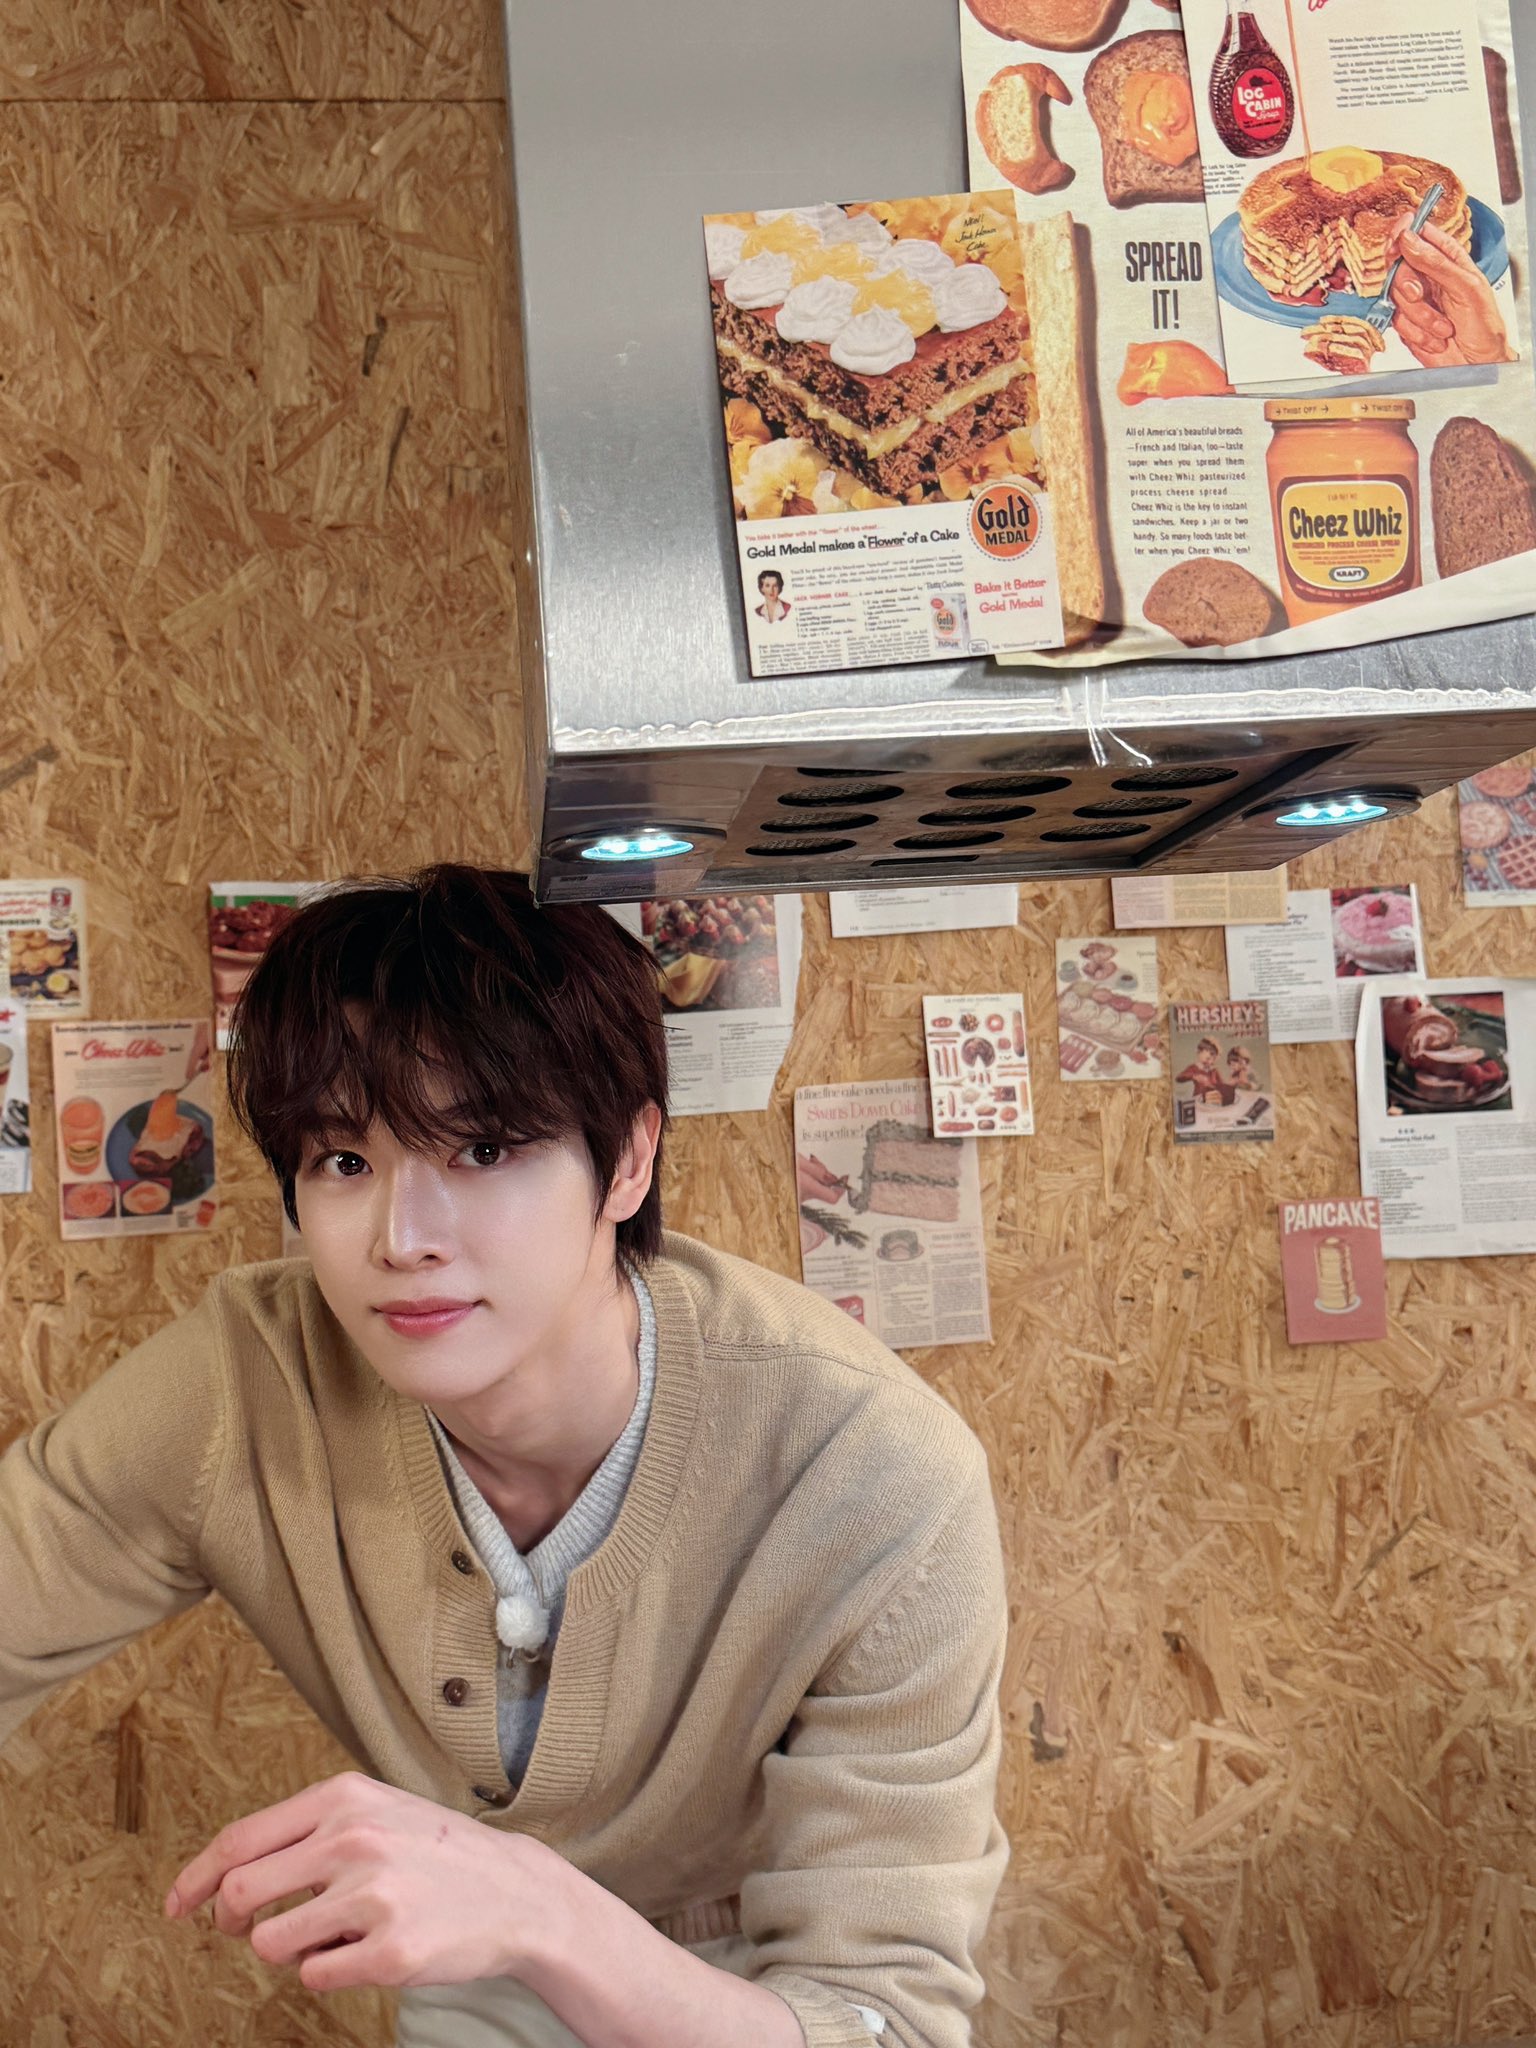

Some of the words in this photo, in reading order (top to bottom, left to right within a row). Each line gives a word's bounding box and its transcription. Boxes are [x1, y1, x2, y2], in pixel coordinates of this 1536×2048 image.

[1237, 87, 1264, 105] LOG
[1246, 97, 1281, 117] CABIN
[1125, 242, 1202, 282] SPREAD
[1153, 290, 1179, 329] IT!
[1126, 428, 1136, 436] All
[1138, 428, 1144, 436] of
[1147, 428, 1182, 436] America's
[1184, 427, 1216, 435] beautiful
[1219, 427, 1242, 435] breads
[1162, 443, 1175, 451] and
[1196, 458, 1220, 467] spread
[1226, 457, 1244, 465] them
[1150, 473, 1172, 481] Cheez
[1200, 473, 1245, 481] pasteurized
[1131, 489, 1161, 497] process
[1167, 488, 1194, 496] cheese
[977, 495, 1030, 531] Gold
[1131, 502, 1152, 511] Cheez
[1156, 503, 1172, 511] Whiz
[1176, 503, 1181, 511] is
[1184, 503, 1195, 511] the
[1198, 503, 1210, 512] key
[1213, 503, 1219, 511] to
[1180, 518, 1199, 526] Keep
[1289, 506, 1348, 539] Cheez
[1354, 506, 1402, 537] Whiz
[747, 547, 775, 559] Gold
[779, 542, 816, 556] Medal
[819, 540, 855, 553] makes
[907, 534, 919, 544] of
[930, 529, 959, 542] Cake
[986, 530, 1031, 545] MEDAL
[1160, 532, 1169, 540] So
[1172, 533, 1191, 541] many
[1194, 532, 1212, 540] foods
[1215, 532, 1232, 540] taste
[1172, 548, 1184, 556] you
[1188, 546, 1210, 554] Cheez
[1213, 546, 1230, 554] Whiz
[975, 582, 1001, 594] Bake
[1004, 581, 1011, 590] it
[1015, 579, 1046, 590] Better
[980, 603, 1006, 613] Gold
[1010, 597, 1043, 610] Medal
[1177, 1004, 1265, 1026] HERSHEY'S
[808, 1108, 848, 1121] Swans
[851, 1103, 887, 1119] Down
[1284, 1200, 1378, 1235] PANCAKE
